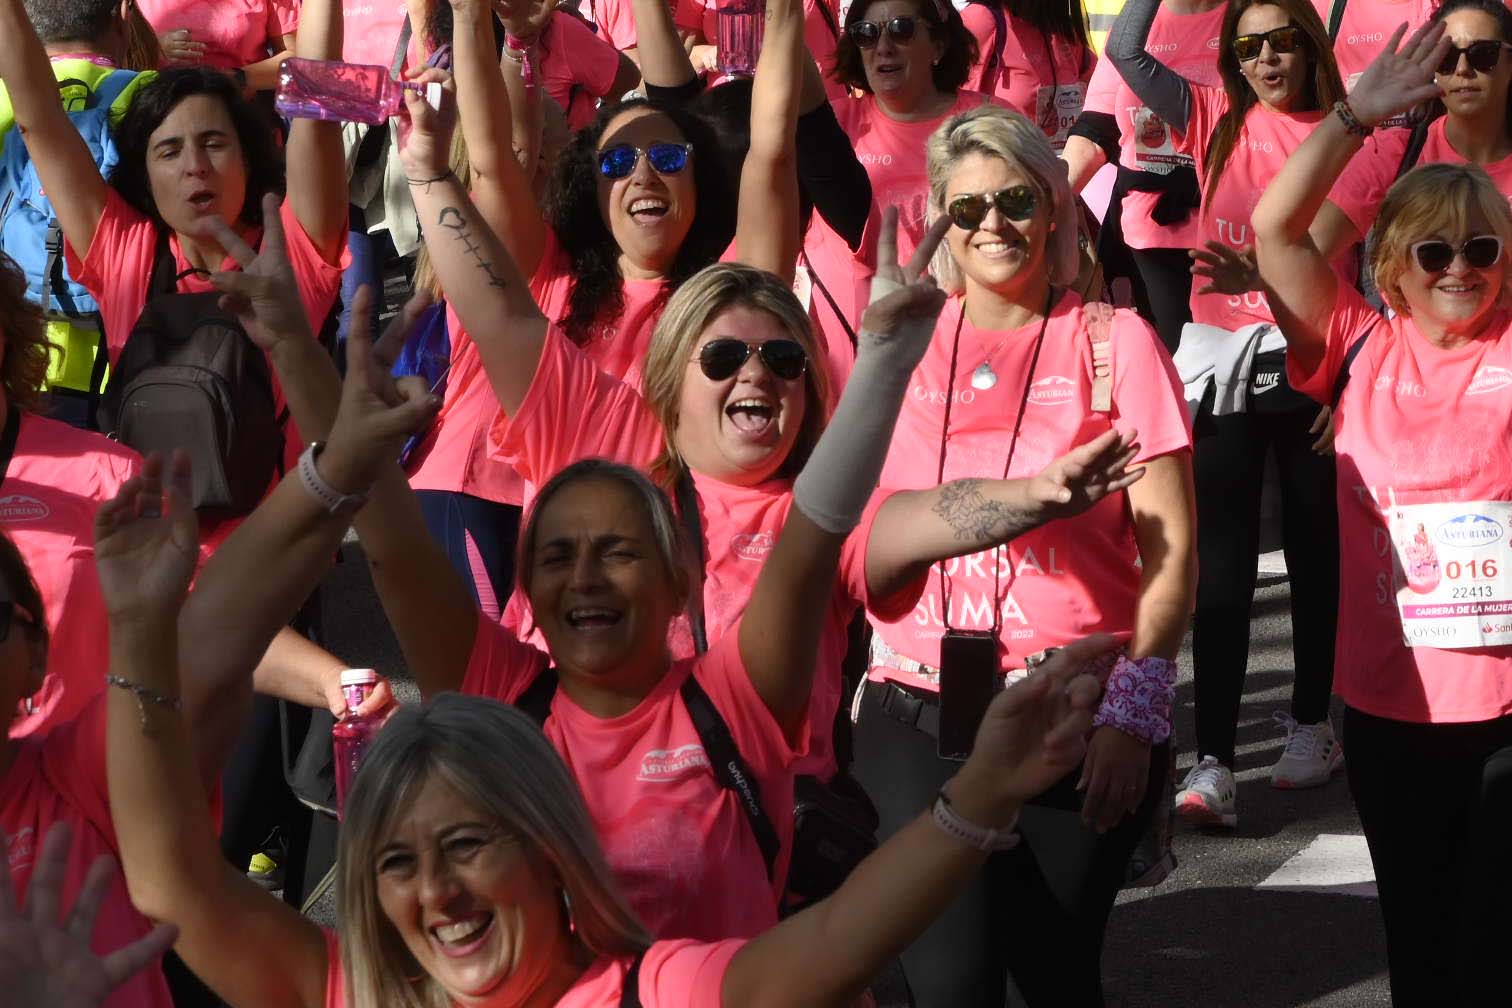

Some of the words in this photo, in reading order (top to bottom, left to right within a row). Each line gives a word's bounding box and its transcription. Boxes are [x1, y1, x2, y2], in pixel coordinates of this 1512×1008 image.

[1347, 31, 1383, 44] OYSHO
[1215, 218, 1246, 245] TU
[1255, 372, 1280, 385] NIKE
[1442, 527, 1498, 541] ASTURIANA
[1446, 559, 1498, 580] 016
[1452, 586, 1493, 599] 22413
[914, 591, 1029, 626] SUMA
[1416, 605, 1455, 616] CARRERA
[1456, 605, 1470, 614] DE
[1471, 604, 1483, 614] LA
[1011, 629, 1034, 639] 2023
[1413, 626, 1457, 638] OYSHO
